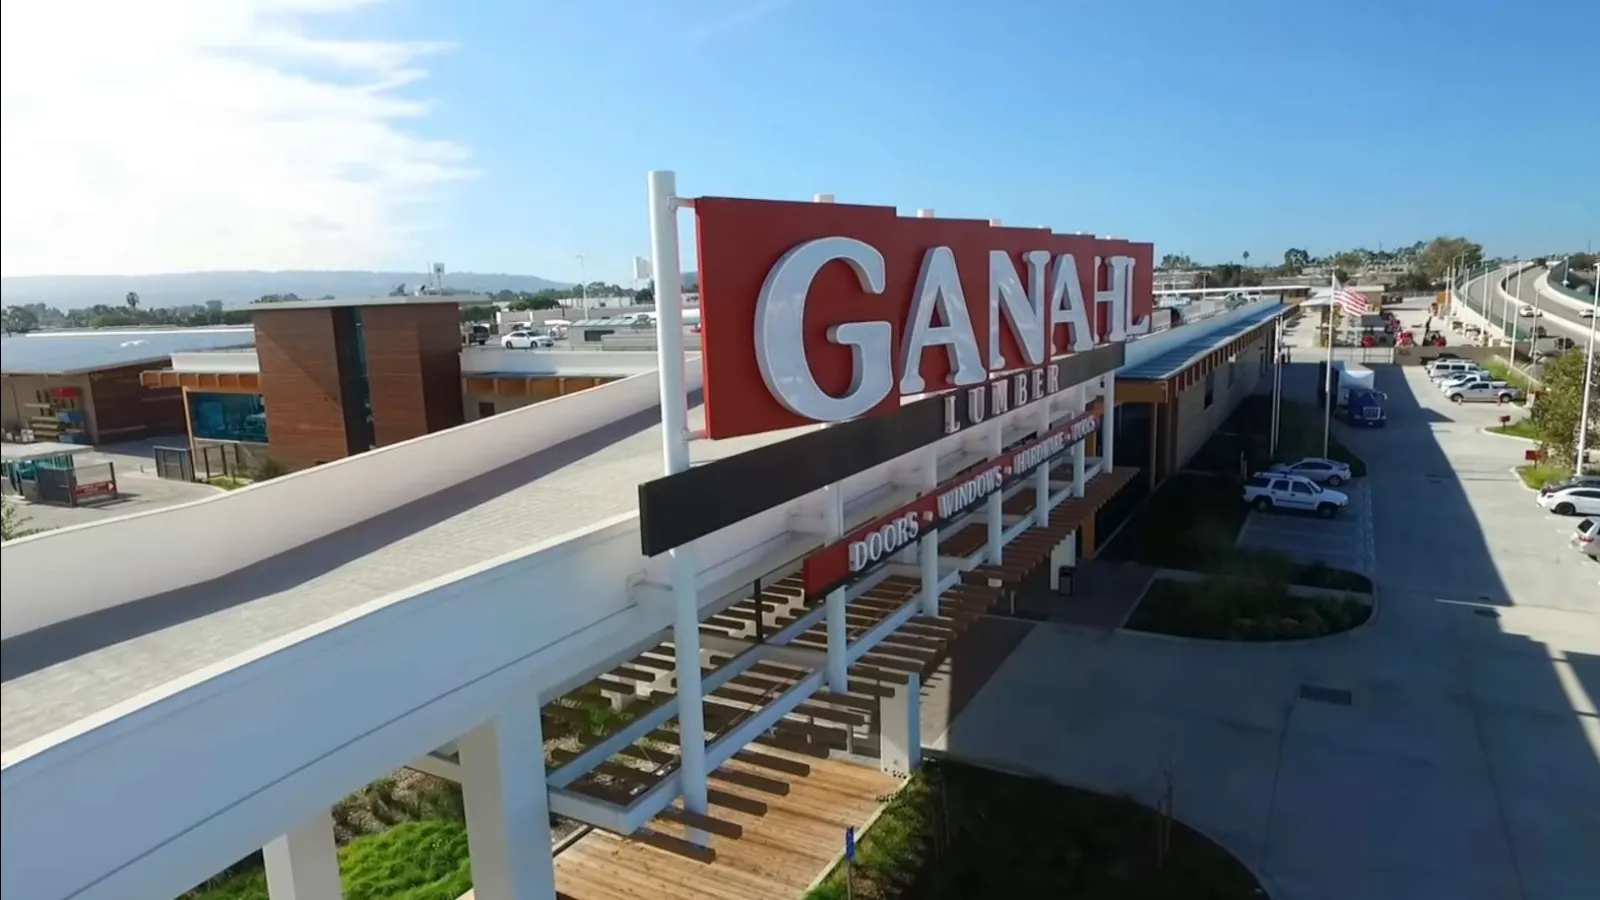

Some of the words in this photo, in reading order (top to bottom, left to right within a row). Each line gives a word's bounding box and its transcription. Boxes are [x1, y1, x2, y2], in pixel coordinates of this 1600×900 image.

[754, 236, 1149, 422] GANAHL
[944, 364, 1060, 434] LUMBER
[848, 511, 919, 572] DOORS
[936, 466, 1003, 518] WINDOWS
